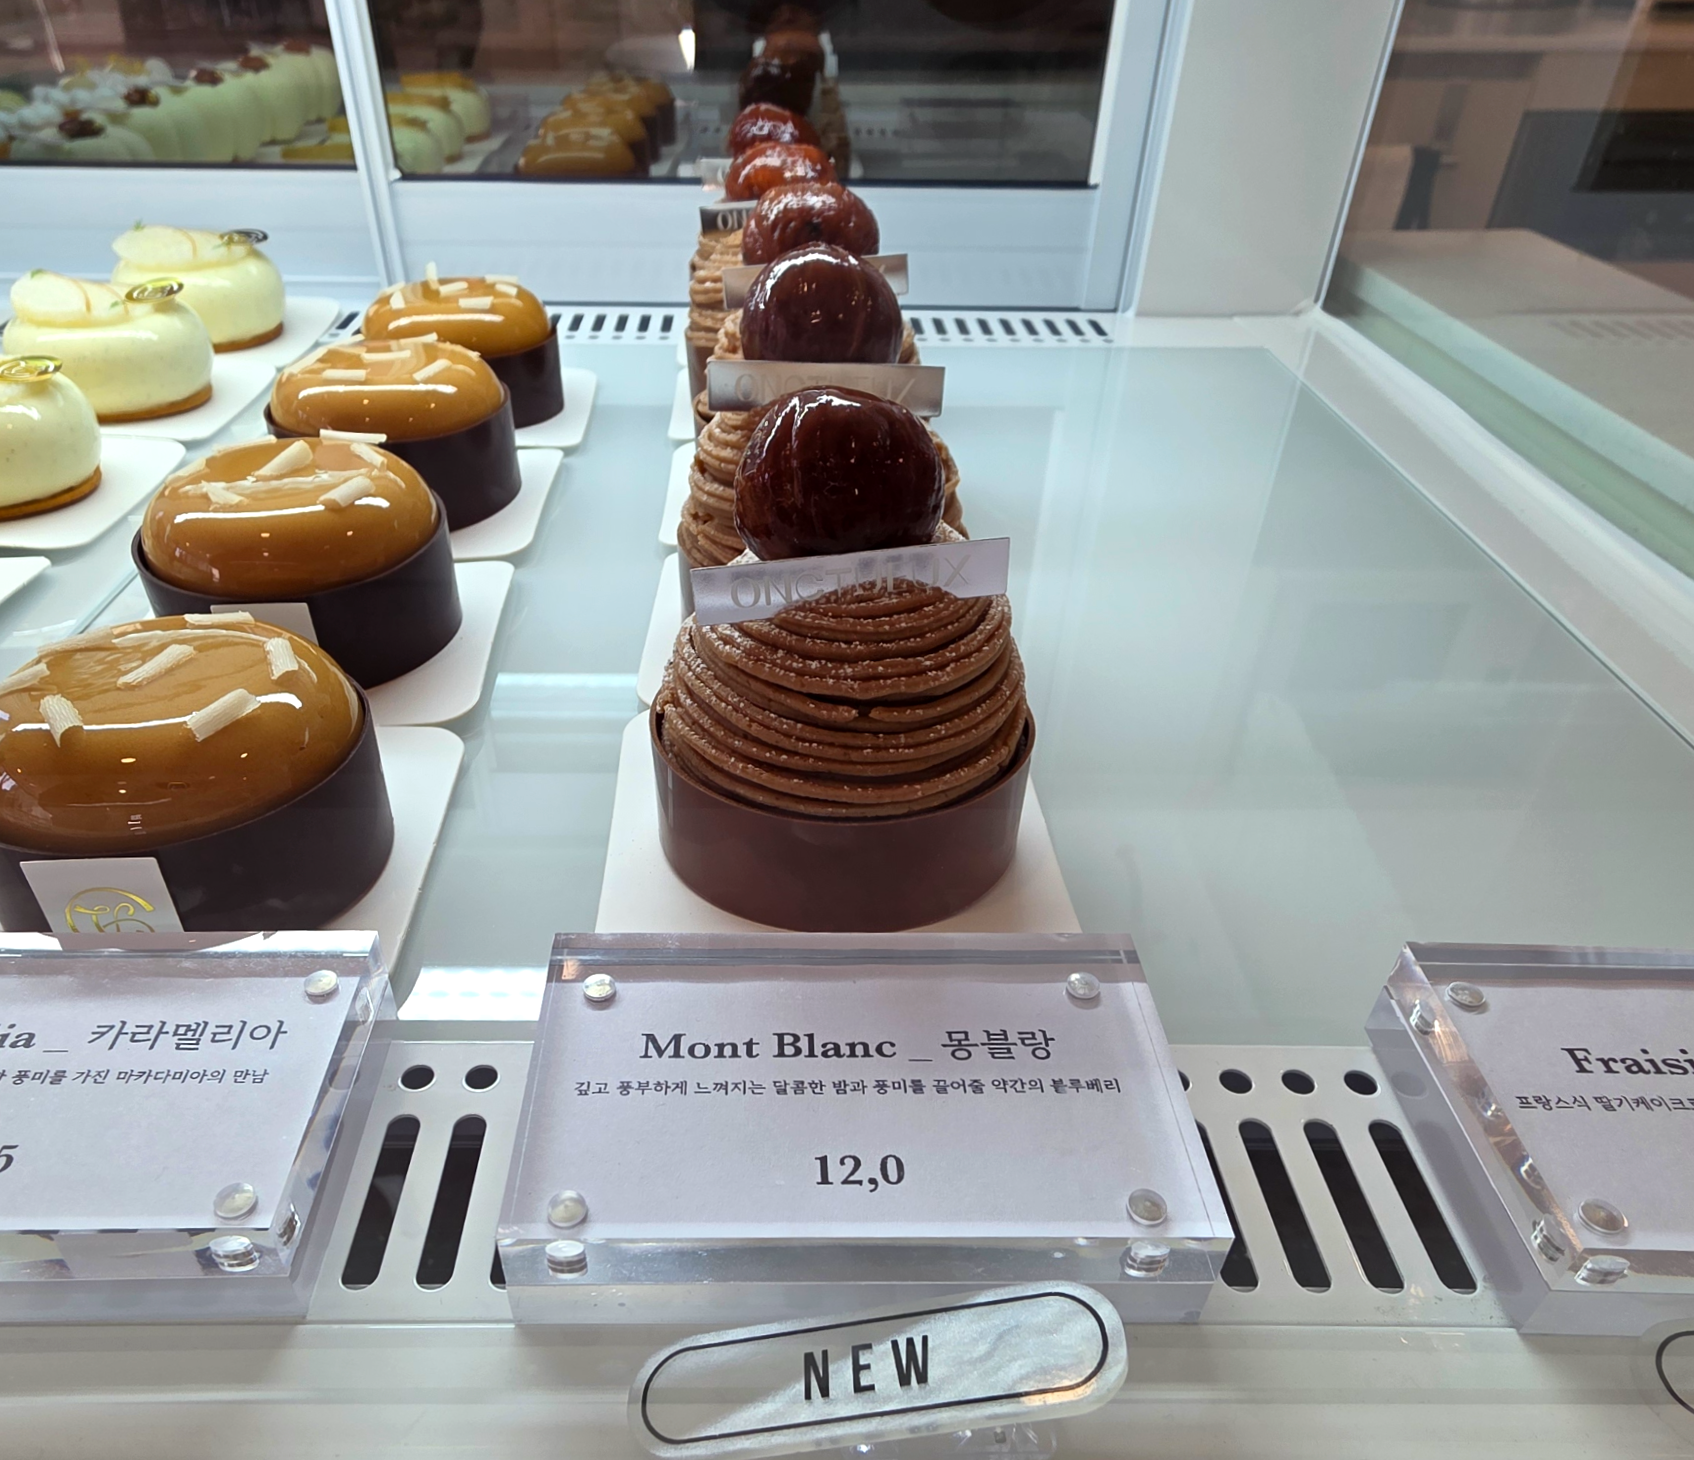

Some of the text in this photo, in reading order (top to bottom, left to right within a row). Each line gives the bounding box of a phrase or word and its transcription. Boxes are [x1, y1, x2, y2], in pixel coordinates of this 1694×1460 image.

[730, 553, 973, 609] ONCTUEUX
[88, 1019, 288, 1051] 카라멜리아
[639, 1033, 760, 1060] Mont
[772, 1032, 897, 1059] Blanc
[941, 1028, 1056, 1061] 몽블랑
[11, 1069, 68, 1086] 풍미를
[72, 1068, 111, 1085] 가진
[116, 1068, 227, 1085] 마카다미아의
[233, 1068, 270, 1085] 만남
[574, 1080, 610, 1096] 깊고
[616, 1080, 688, 1097] 풍부하게
[694, 1079, 767, 1096] 느껴지는
[772, 1079, 827, 1096] 달콤한
[832, 1079, 868, 1095] 밤과
[872, 1078, 927, 1096] 풍미를
[932, 1078, 986, 1095] 끌어줄
[991, 1077, 1045, 1094] 약간의
[1515, 1094, 1592, 1112] 프랑스식
[814, 1154, 906, 1193] 12,0
[803, 1334, 929, 1401] NEW
